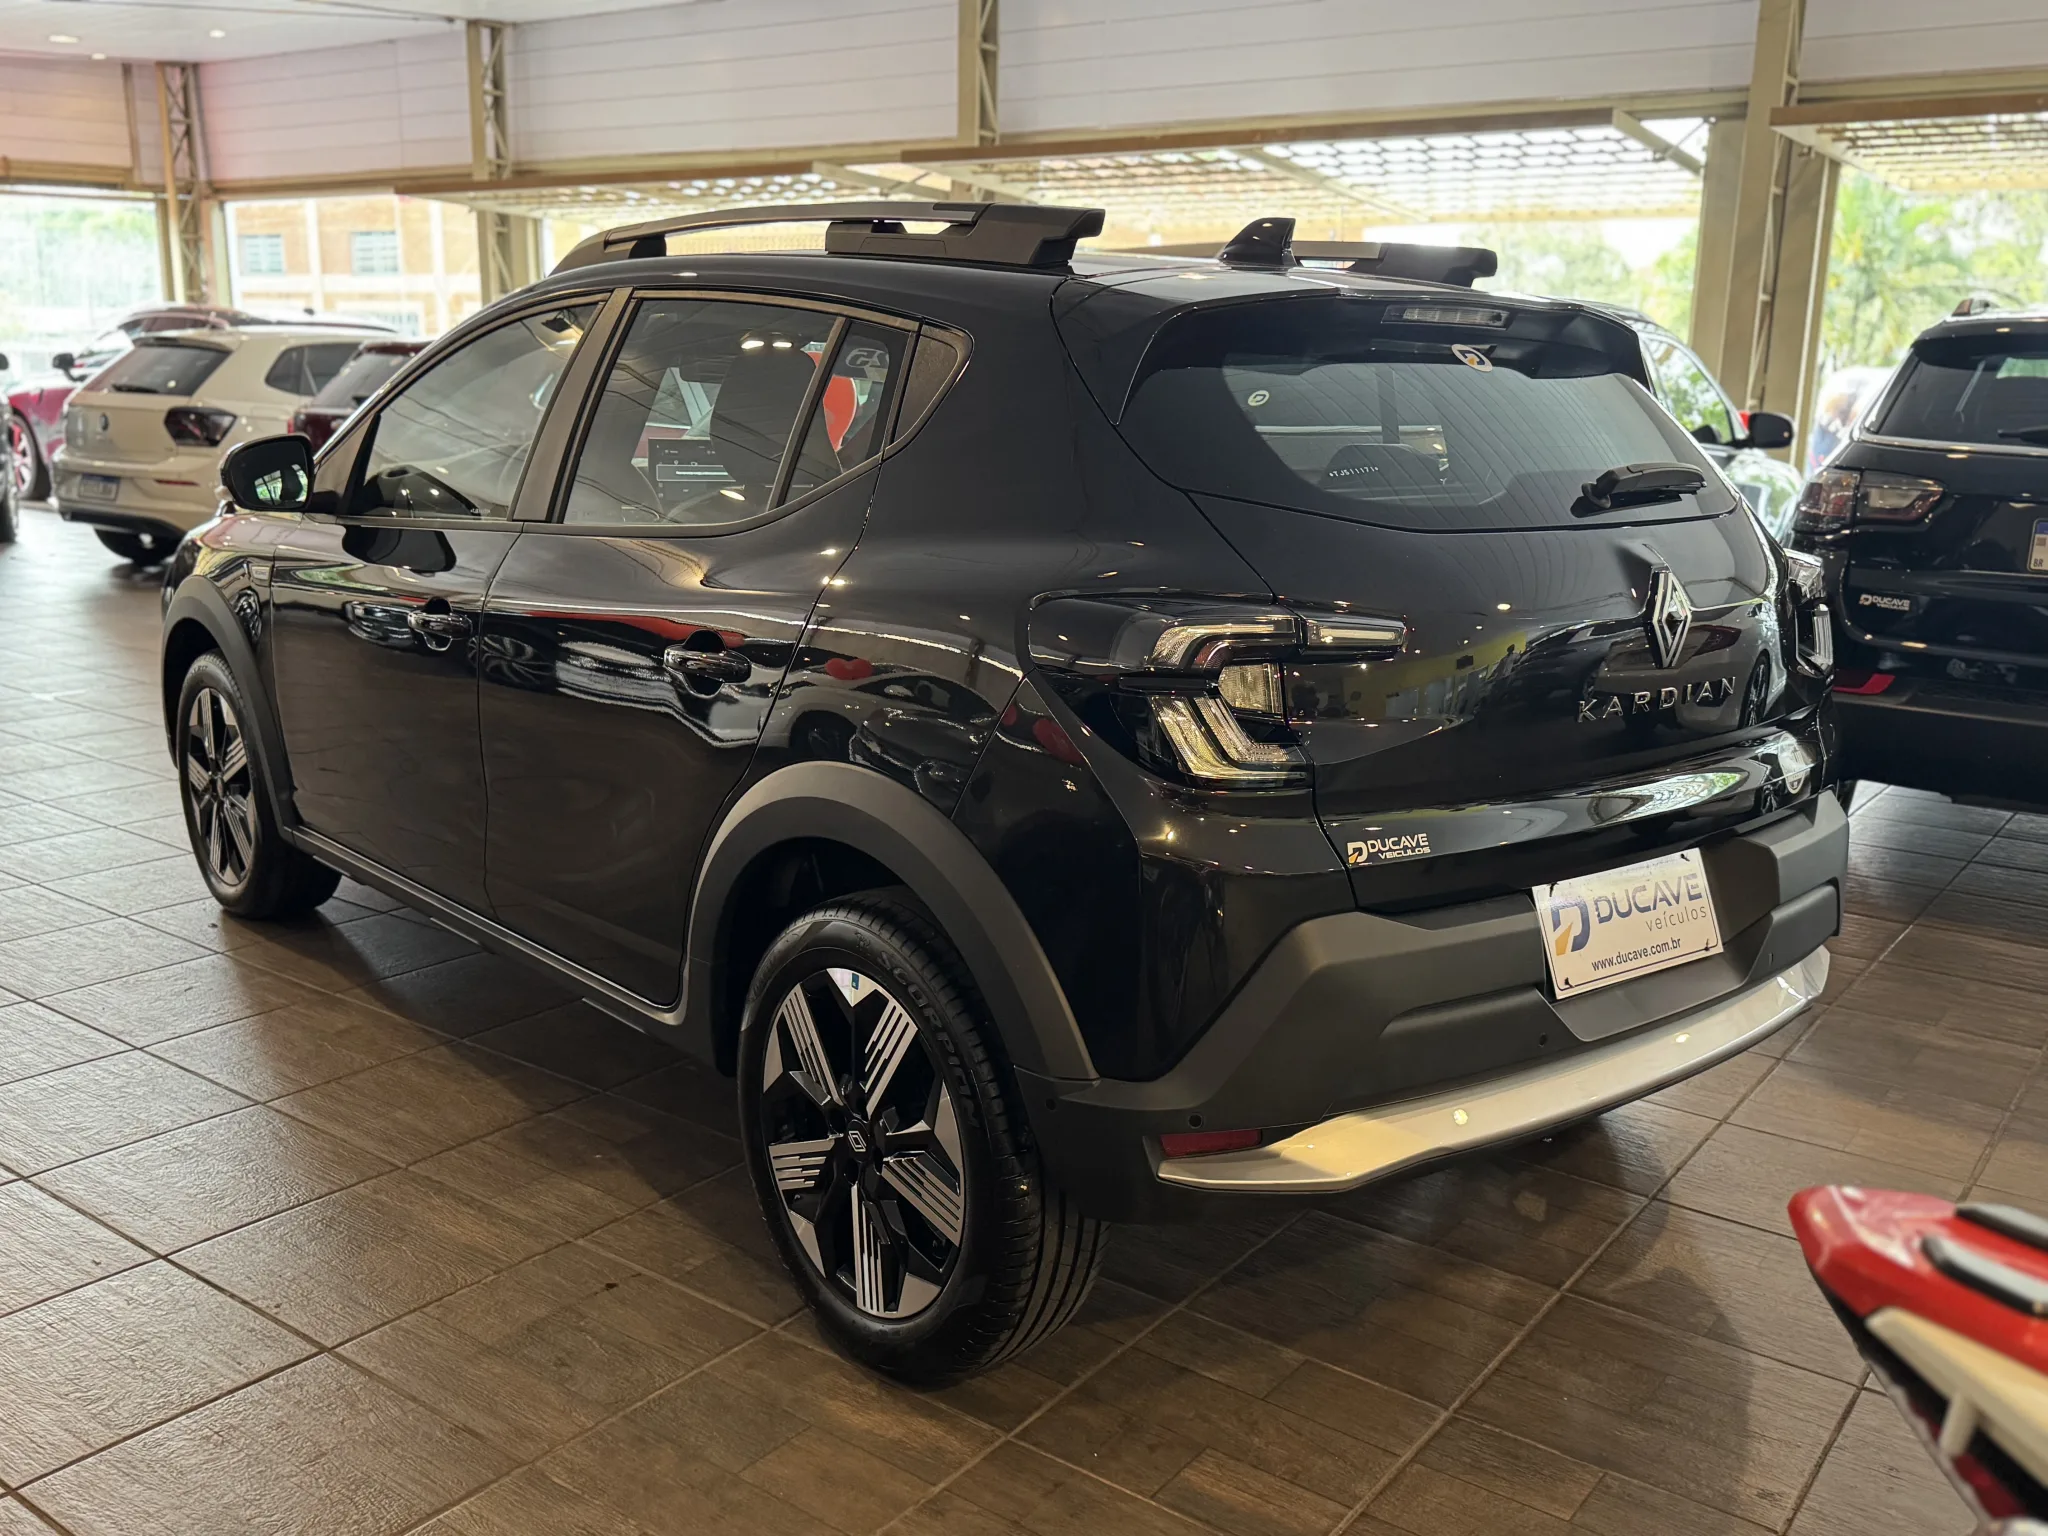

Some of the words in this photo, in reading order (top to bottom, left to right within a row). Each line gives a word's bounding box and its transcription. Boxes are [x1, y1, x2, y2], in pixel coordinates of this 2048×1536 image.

[1577, 676, 1736, 723] KARDIAN
[1367, 833, 1429, 853] DUCAVE
[1378, 846, 1431, 860] VEICULOS
[1593, 872, 1703, 925] DUCAVE
[1645, 905, 1707, 932] veículos
[1591, 937, 1681, 972] www.ducave.com.br
[877, 951, 981, 1129] SCORPION
